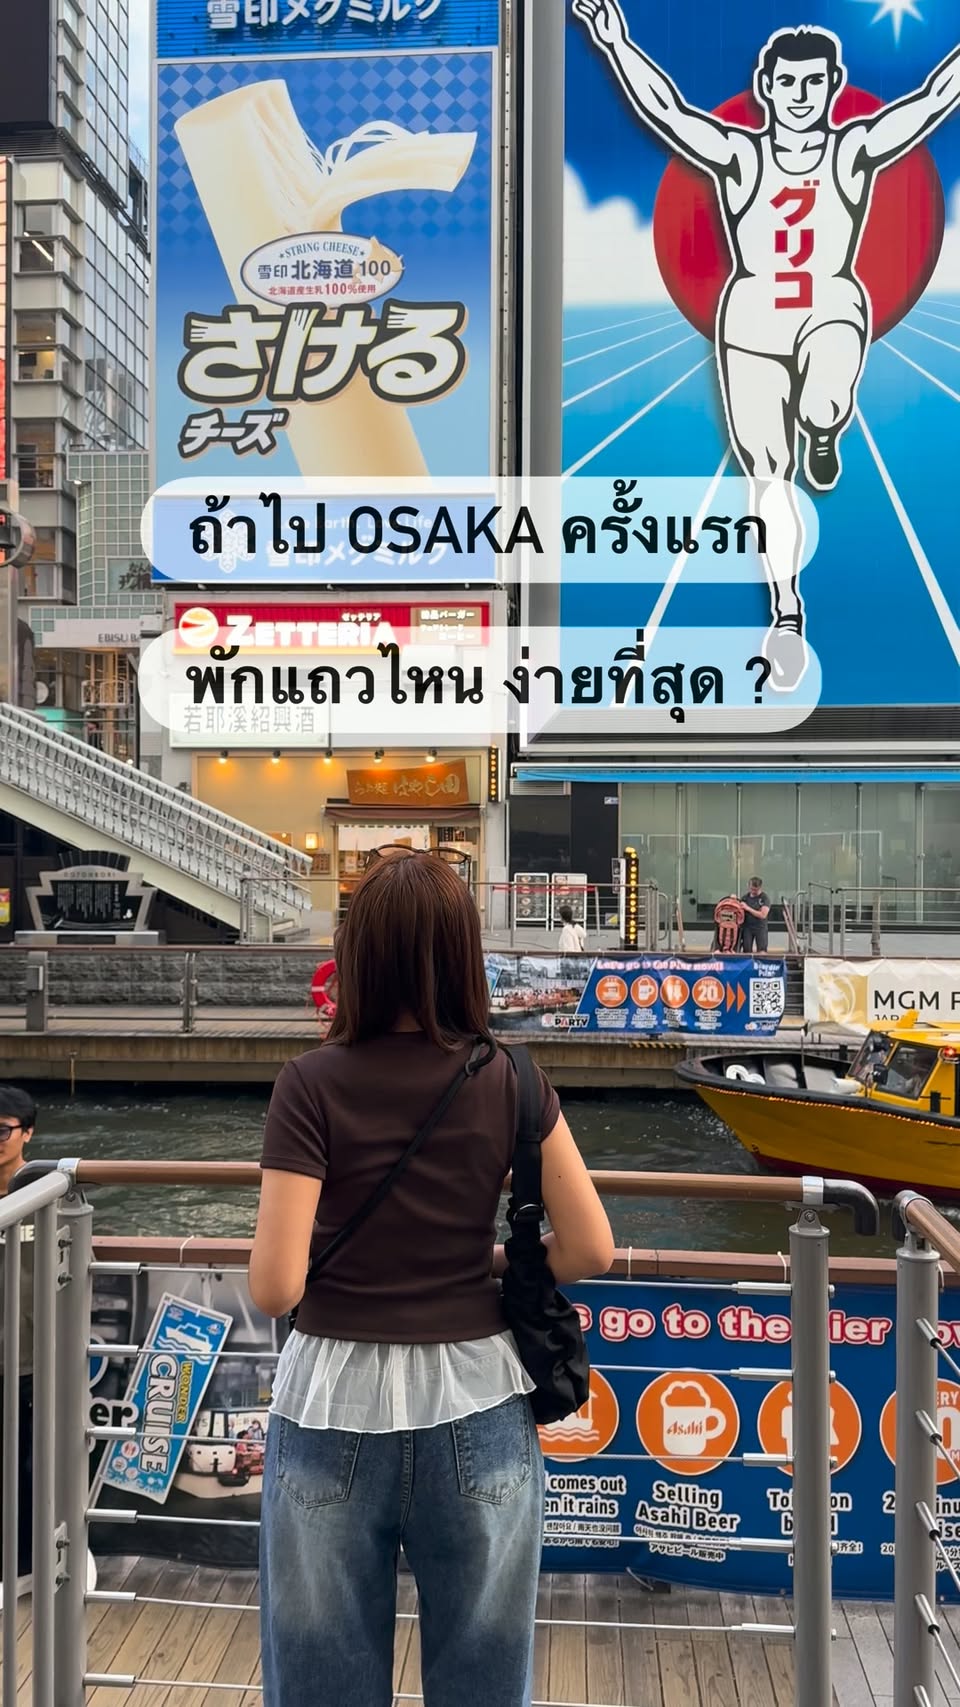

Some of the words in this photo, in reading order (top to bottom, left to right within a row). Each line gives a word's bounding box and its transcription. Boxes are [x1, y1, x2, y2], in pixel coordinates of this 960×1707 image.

[285, 241, 320, 258] STRING
[323, 241, 360, 257] CHEESE
[769, 180, 820, 309] グリコ
[258, 264, 288, 279] 雪印
[291, 259, 353, 280] 北海道
[359, 260, 391, 276] 100
[268, 283, 376, 296] 北海道産生乳100%使用
[180, 302, 466, 402] さける
[180, 409, 289, 457] チーズ
[226, 615, 397, 647] ZETTERIA
[874, 990, 939, 1010] MGM
[554, 1017, 588, 1027] PARTY
[601, 1307, 655, 1342] go
[662, 1303, 711, 1339] to
[717, 1305, 792, 1343] the
[829, 1310, 893, 1345] ier
[176, 1361, 193, 1423] WONDER
[140, 1353, 178, 1474] CRUISE
[667, 1420, 703, 1435] Asahi
[551, 1475, 596, 1491] comes
[601, 1477, 625, 1492] out
[563, 1497, 574, 1513] it
[578, 1498, 616, 1515] rains
[655, 1483, 720, 1509] Selling
[638, 1502, 688, 1526] Asahi
[695, 1511, 738, 1529] Beer
[650, 1542, 724, 1560] アサヒビール販売中
